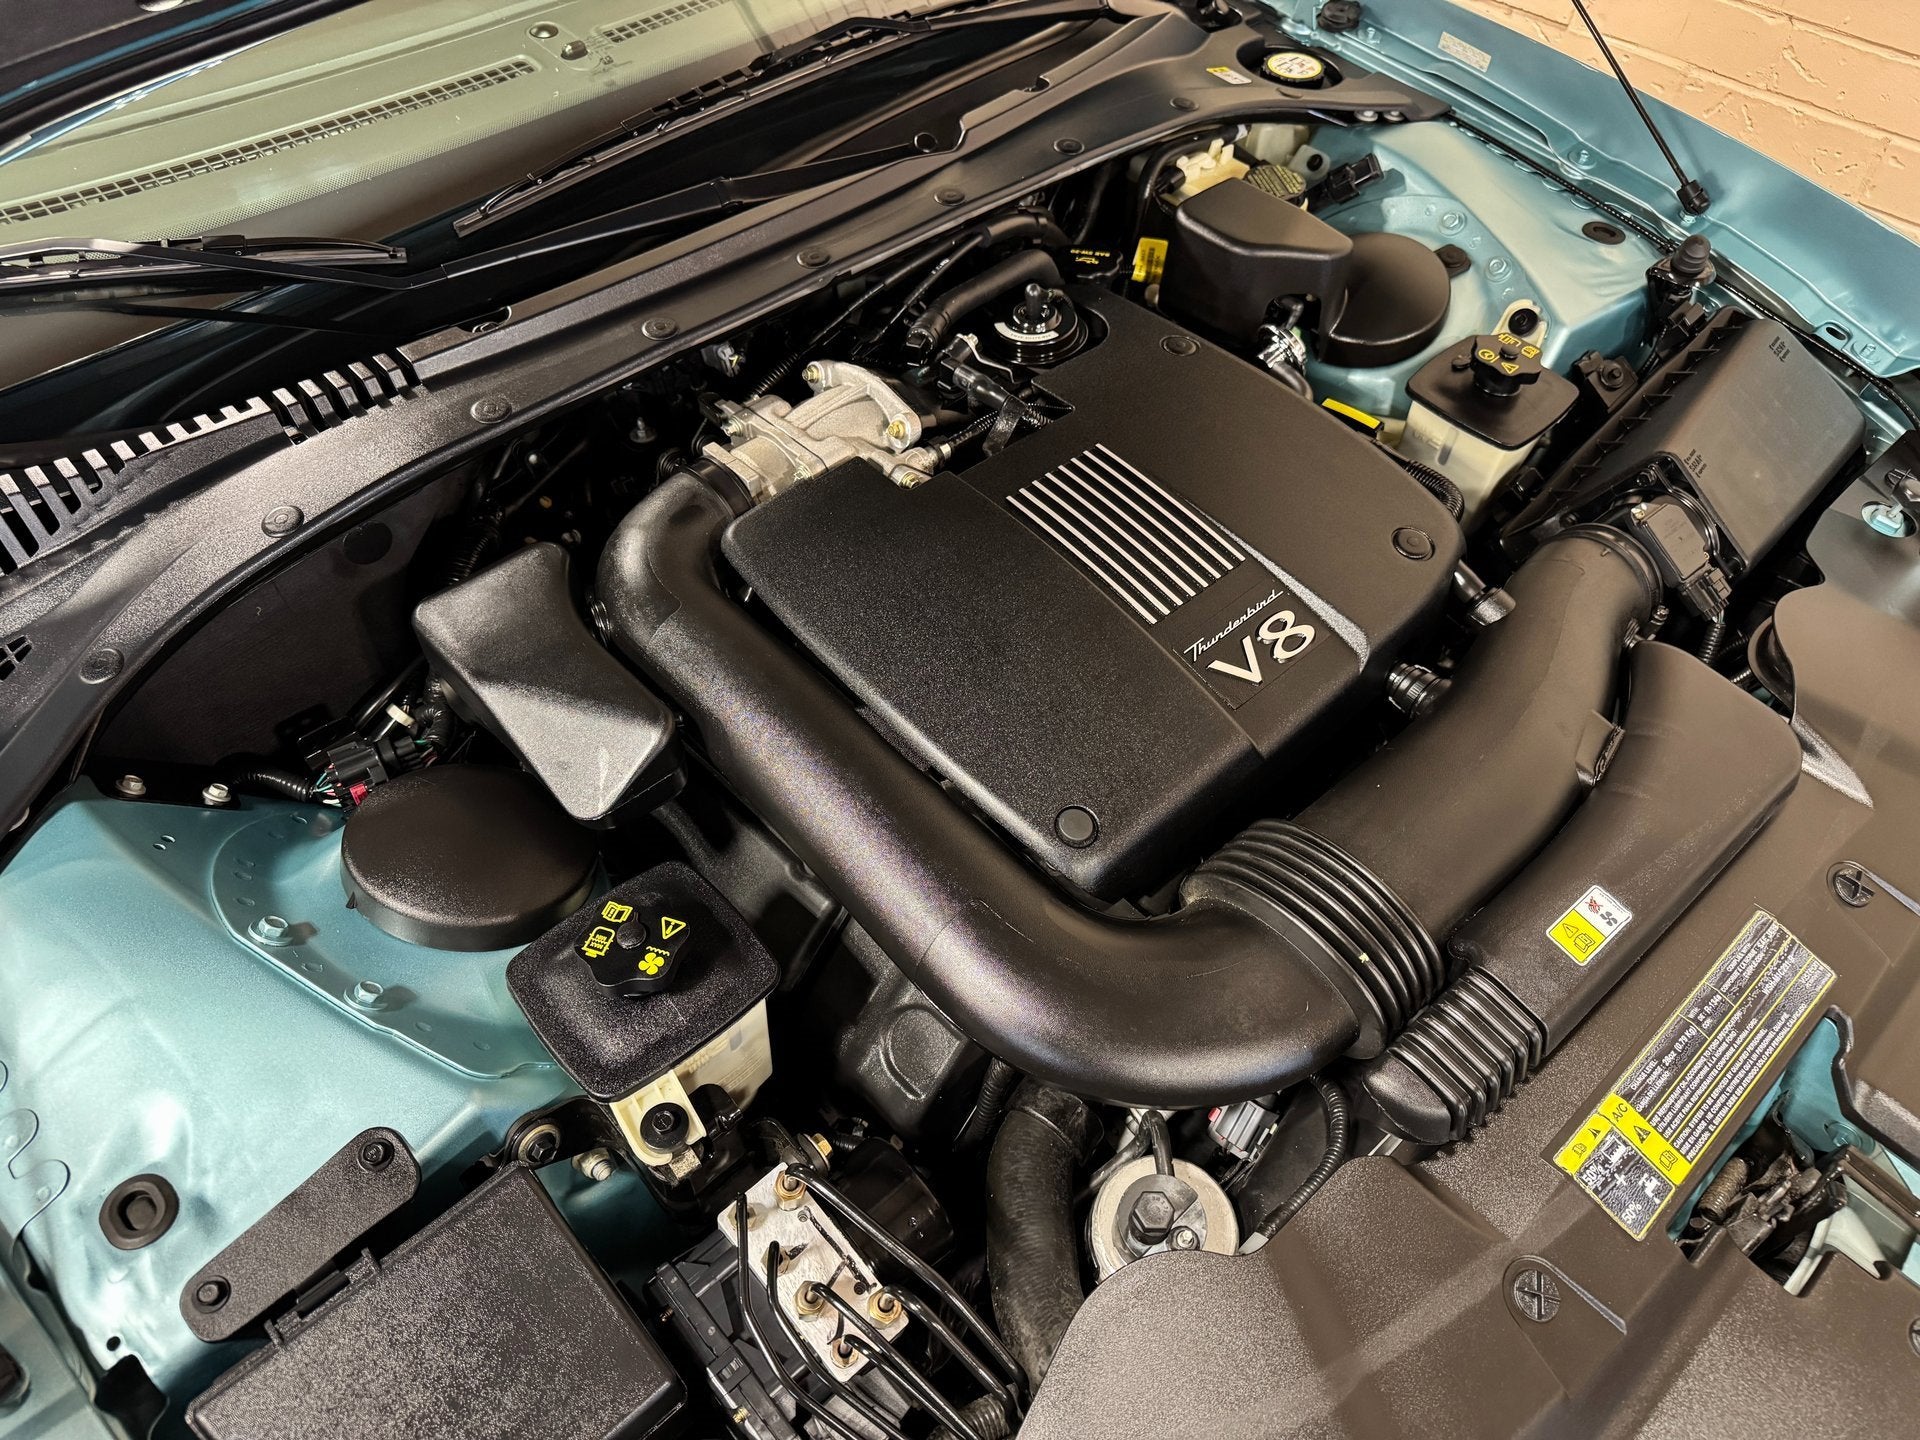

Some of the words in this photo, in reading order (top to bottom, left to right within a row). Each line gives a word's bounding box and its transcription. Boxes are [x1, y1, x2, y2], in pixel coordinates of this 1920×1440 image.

[1184, 589, 1284, 663] Thunderbird
[1206, 609, 1316, 687] V8
[1703, 992, 1722, 1014] R-134a
[1629, 1071, 1647, 1090] CHARGE
[1643, 1057, 1658, 1074] LEVEL:
[1649, 1114, 1660, 1126] USE
[1656, 1085, 1683, 1117] REFRIGERANT
[1683, 1054, 1707, 1082] ACCORDING
[1707, 1038, 1720, 1052] FORD
[1655, 1110, 1674, 1132] UTILISER
[1670, 1086, 1693, 1113] LUBRIFIANT
[1688, 1064, 1710, 1090] CONFORME
[1713, 1041, 1728, 1058] NORME
[1725, 1029, 1737, 1043] FORD
[1661, 1048, 1677, 1066] 28oz
[1673, 1034, 1690, 1052] (0.79
[1683, 1024, 1698, 1039] Kg)
[1662, 1126, 1673, 1138] USE
[1669, 1111, 1685, 1129] ACEITE
[1680, 1100, 1694, 1114] PARA
[1689, 1067, 1719, 1103] REFRIGERANTES
[1715, 1045, 1736, 1070] CONFORME
[1734, 1028, 1749, 1045] NORMA
[1711, 1104, 1730, 1125] SISTEMA
[1725, 1092, 1738, 1108] DEBE
[1733, 1084, 1745, 1096] SER
[1740, 1064, 1760, 1088] ATENDIDO
[1755, 1053, 1768, 1068] SOLO
[1764, 1045, 1775, 1057] POR
[1770, 1024, 1790, 1048] PERSONAL
[1612, 1103, 1629, 1124] A/C
[1672, 1125, 1692, 1148] CAUTION:
[1687, 1108, 1705, 1128] SYSTEM
[1709, 1076, 1729, 1099] SERVICED
[1729, 1049, 1750, 1073] QUALIFIED
[1678, 1140, 1691, 1154] MISE
[1691, 1119, 1707, 1137] GARDE
[1709, 1093, 1727, 1114] CONFIER
[1754, 1028, 1776, 1055] PERSONNEL
[1582, 1160, 1604, 1184] 50%
[1621, 1200, 1644, 1226] 50%
